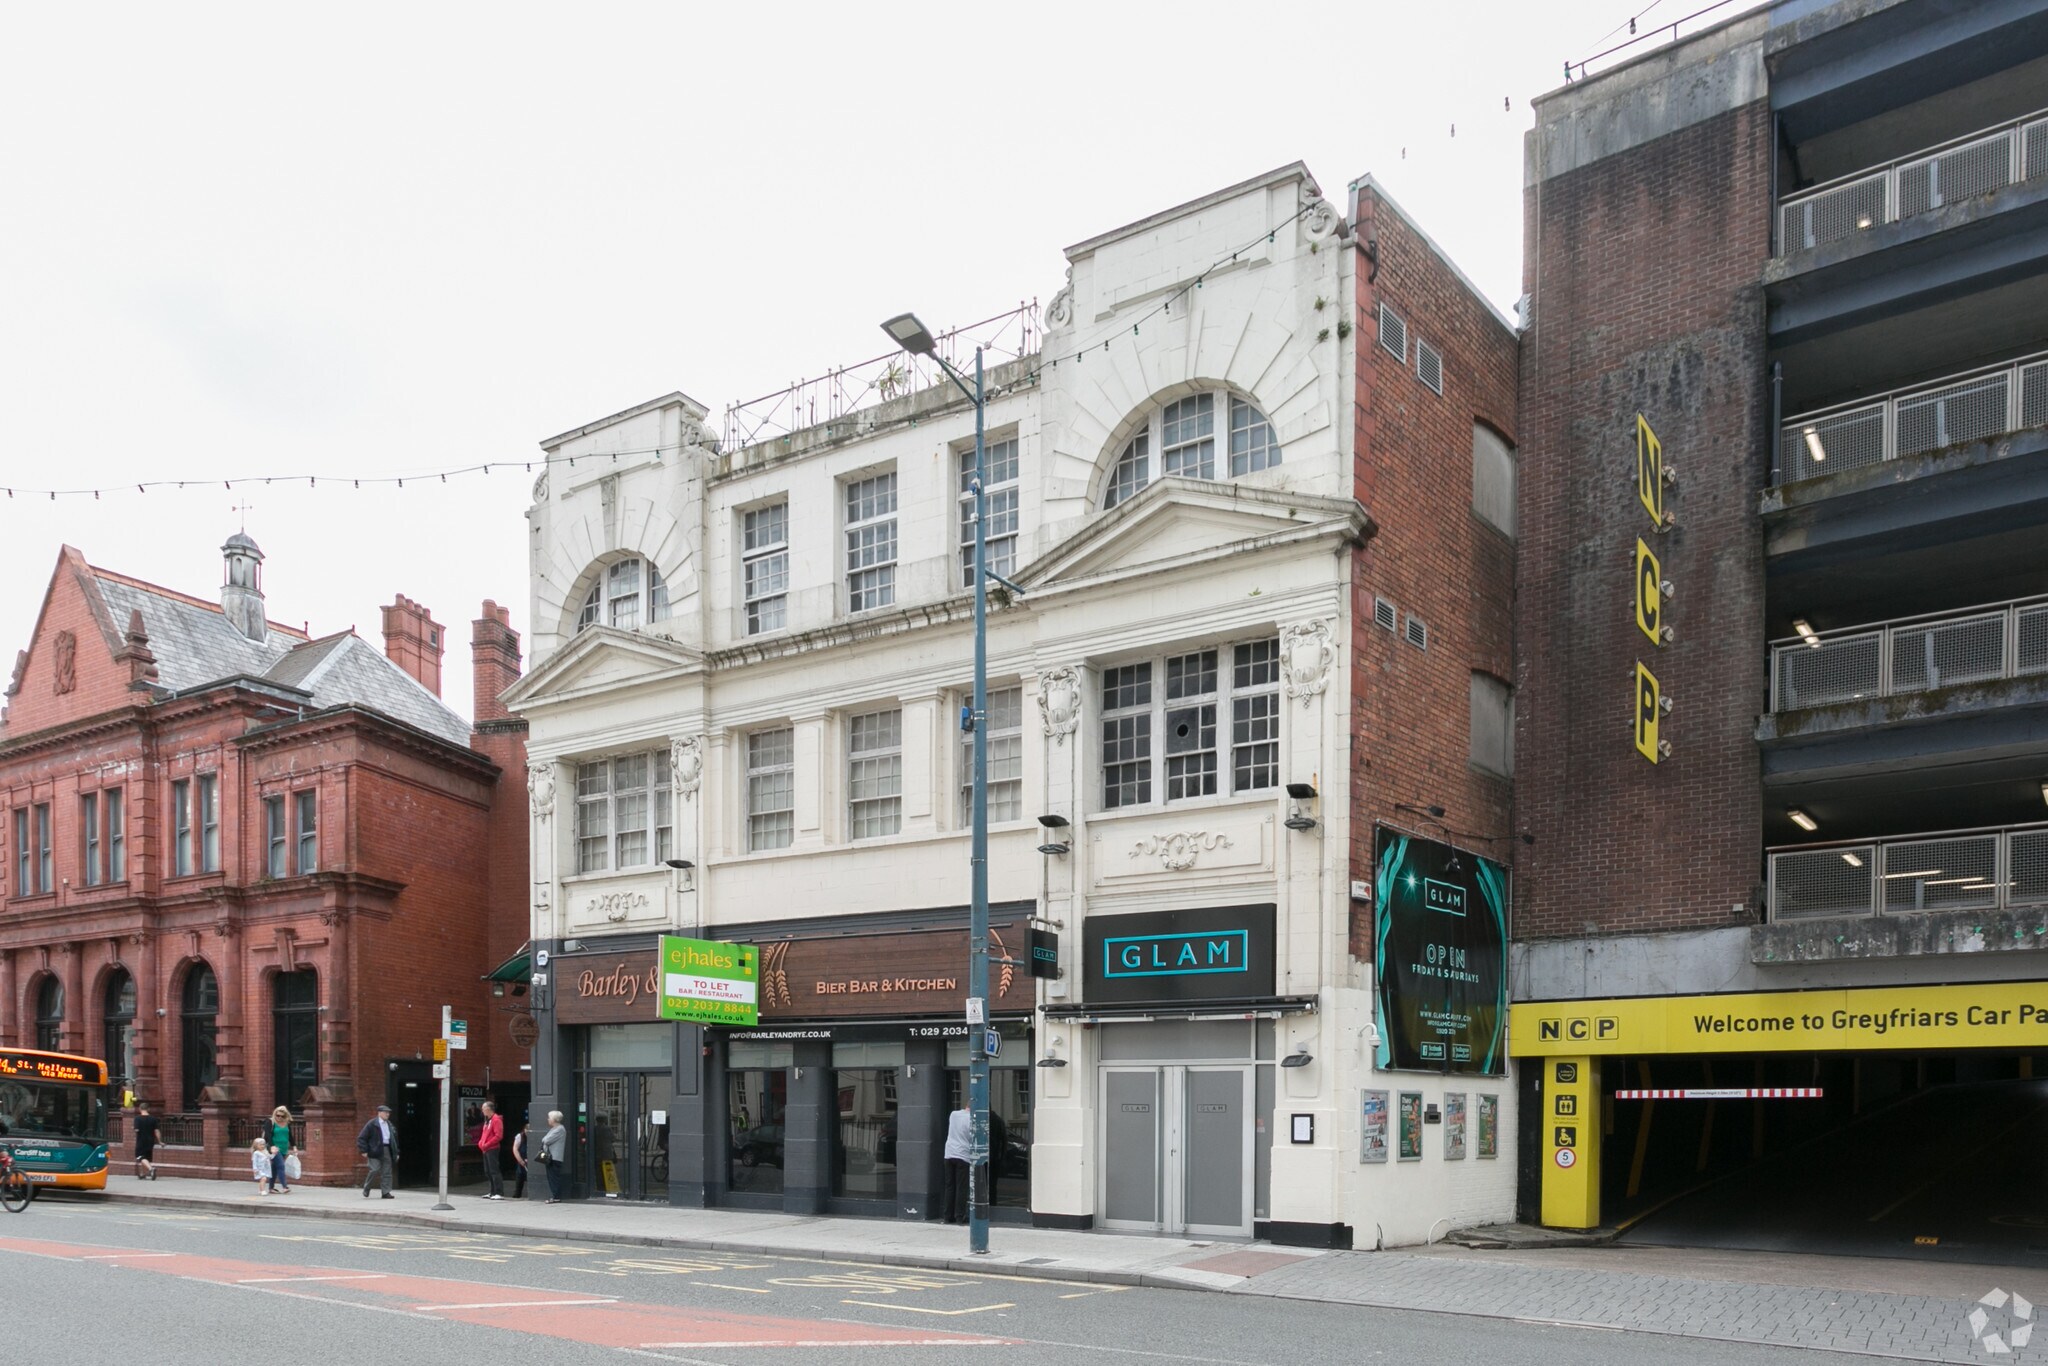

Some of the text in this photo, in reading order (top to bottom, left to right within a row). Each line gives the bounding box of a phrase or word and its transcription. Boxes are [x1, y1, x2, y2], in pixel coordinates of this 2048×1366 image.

[1640, 424, 1660, 745] NCP
[1430, 889, 1461, 907] GLAM
[671, 947, 733, 969] ejhales
[1036, 948, 1056, 959] GLAM
[1121, 940, 1230, 968] GLAM
[1426, 943, 1466, 969] OPEN
[1412, 963, 1435, 977] FRDAY
[1444, 968, 1480, 984] SAURDAYS
[577, 963, 659, 1006] Barley &
[694, 980, 730, 991] TO LET
[816, 978, 957, 995] BIER BAR & KITCHEN
[698, 989, 743, 999] RESTAURANT
[667, 997, 752, 1014] 029 2037 8844
[674, 1011, 745, 1022] www.ejhales.co.uk
[1694, 1014, 1795, 1033] Welcome
[1801, 1013, 1824, 1030] to
[1831, 1008, 1959, 1034] Greyfriars
[1967, 1005, 2012, 1026] Car
[729, 1030, 832, 1039] INFO@BARLEYANDRYE.CO.UK
[909, 1027, 969, 1036] T: 029 2034
[1541, 1020, 1616, 1039] NCP
[988, 1034, 994, 1050] P
[17, 1059, 33, 1069] St.
[37, 1062, 79, 1074] Mellons
[14, 1148, 52, 1157] Cardiff bus
[1562, 1152, 1569, 1161] 5
